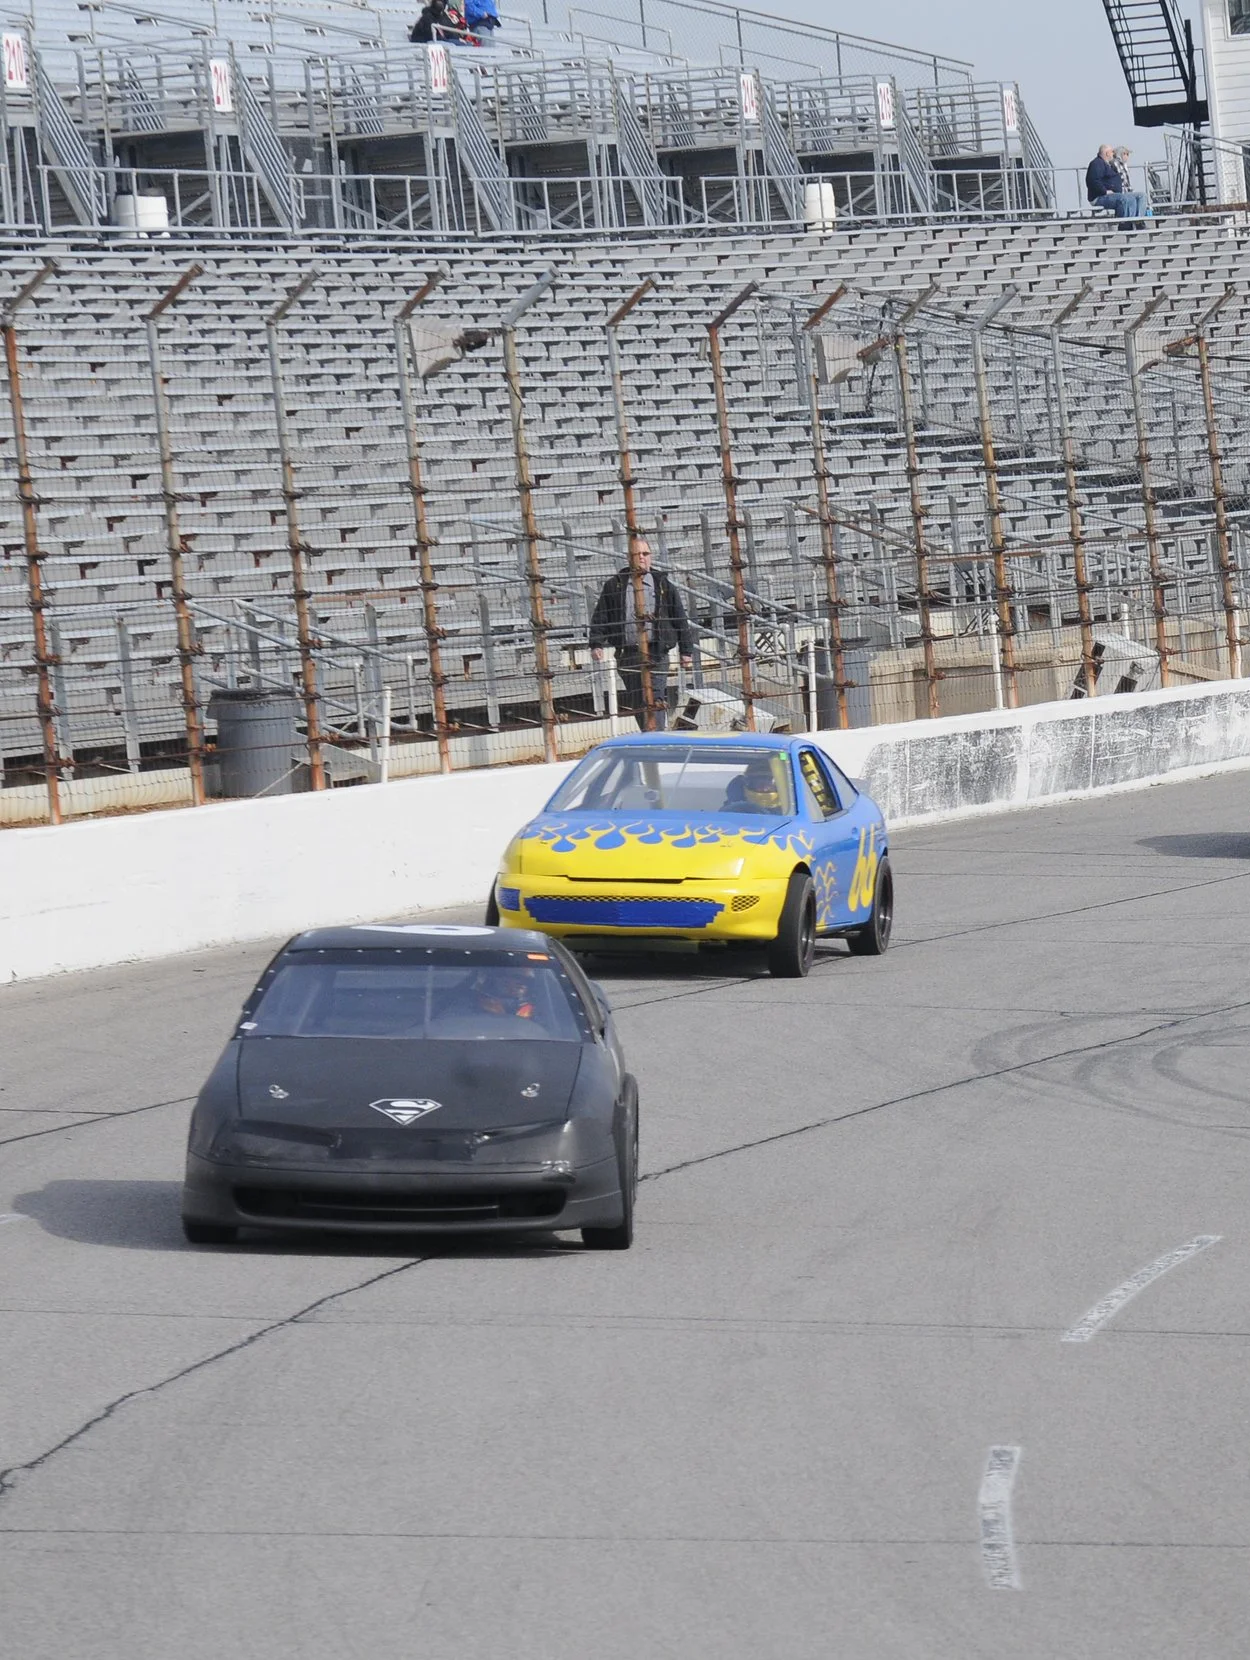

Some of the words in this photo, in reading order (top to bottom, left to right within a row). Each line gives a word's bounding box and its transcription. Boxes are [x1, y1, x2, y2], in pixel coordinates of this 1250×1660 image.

[5, 38, 24, 81] 210
[430, 49, 447, 88] 212
[213, 65, 231, 106] 211
[847, 822, 878, 913] 66
